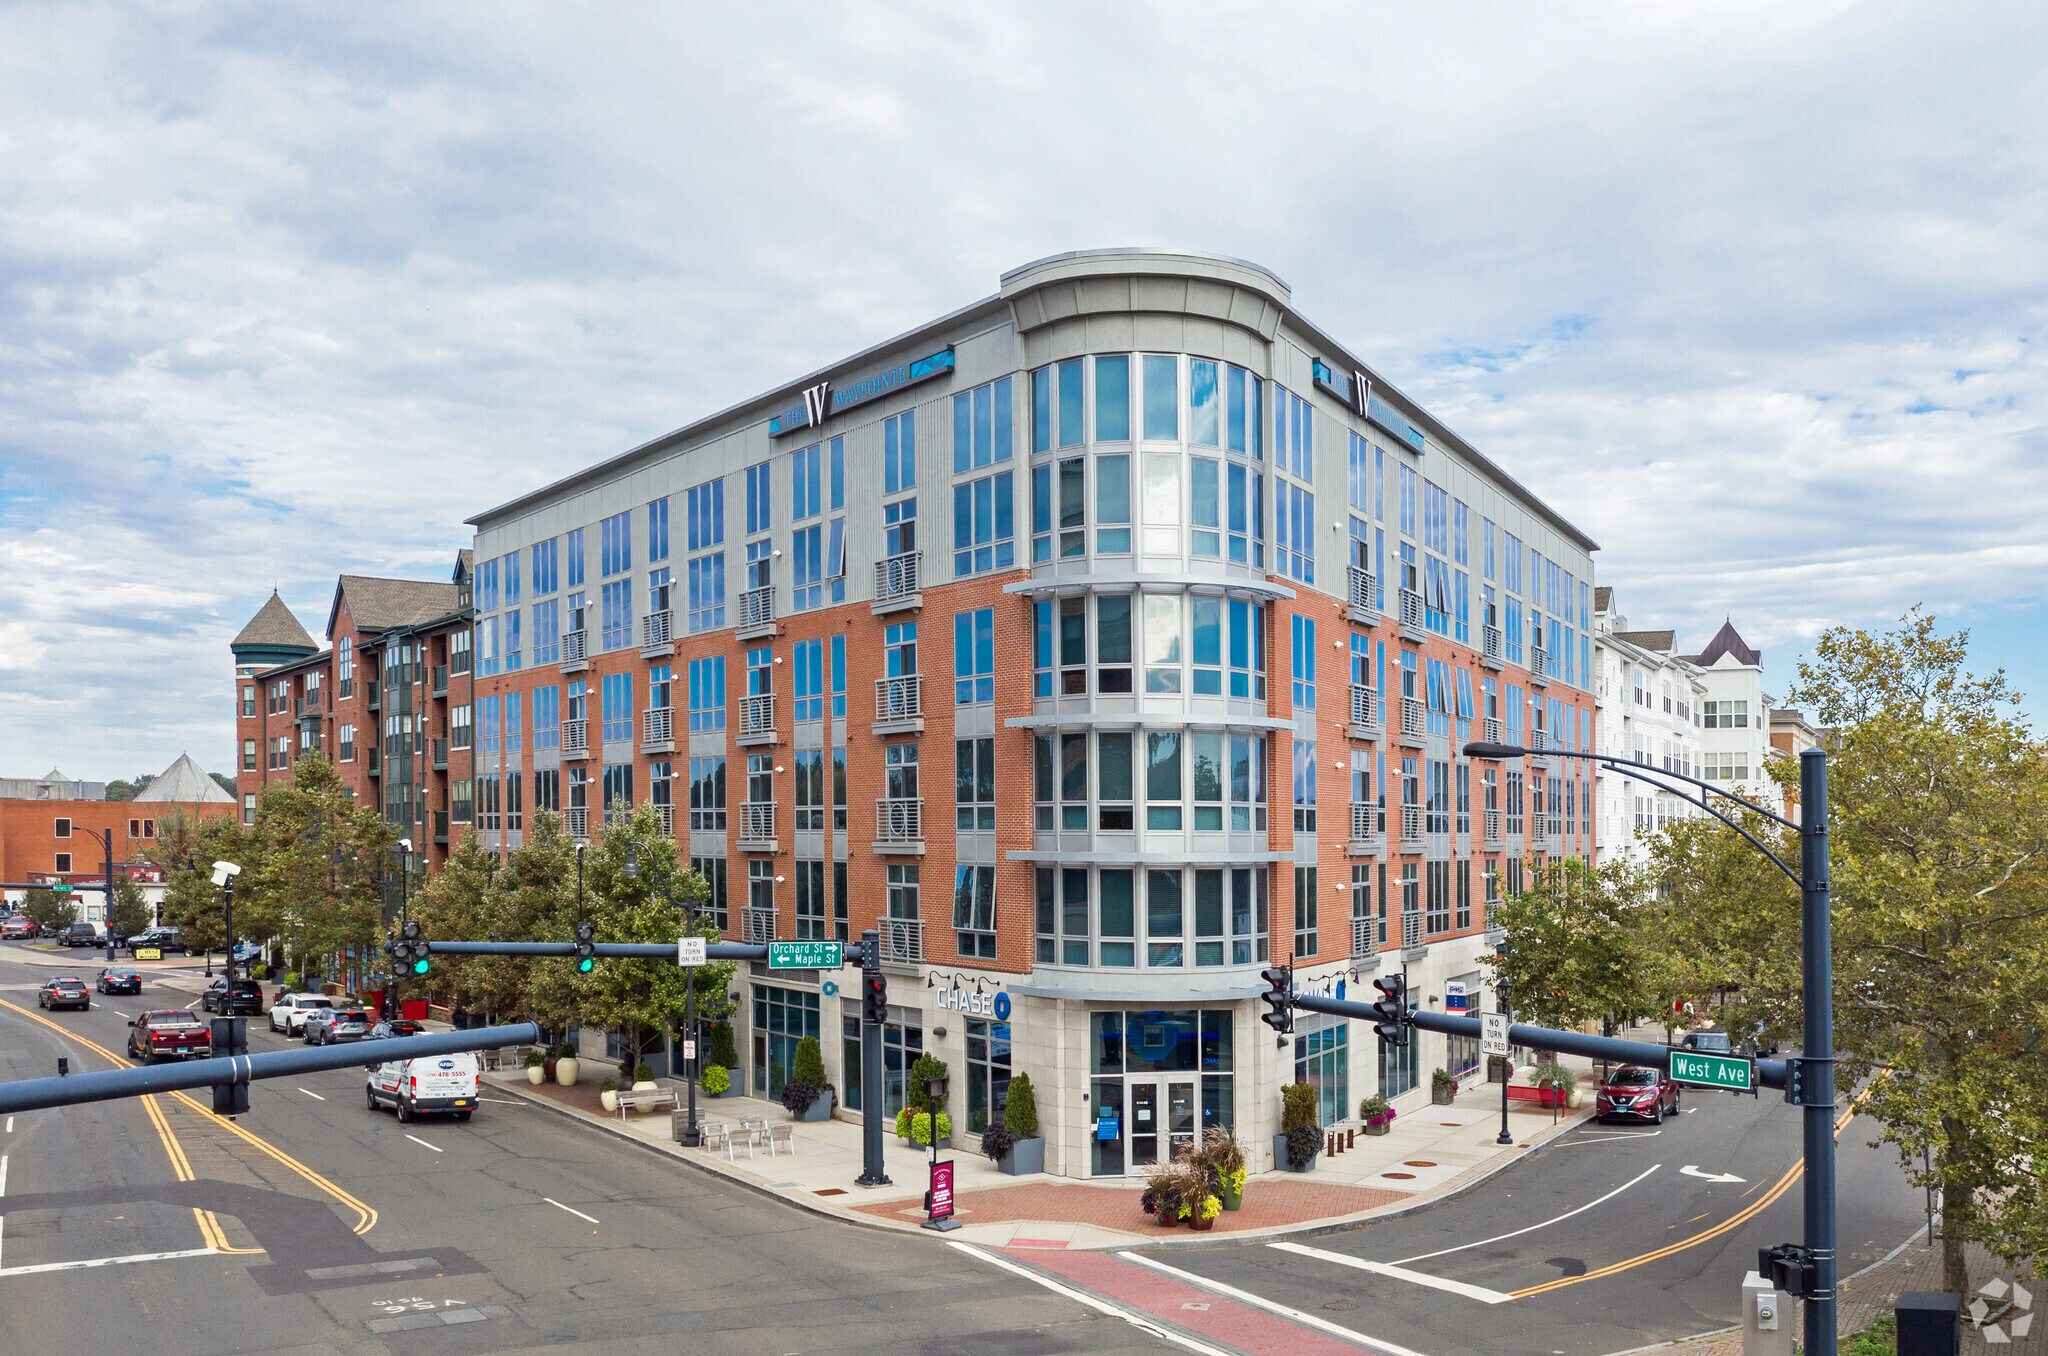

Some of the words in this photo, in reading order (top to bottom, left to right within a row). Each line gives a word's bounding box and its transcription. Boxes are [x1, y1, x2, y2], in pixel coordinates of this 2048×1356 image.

[784, 405, 804, 427] THE
[802, 381, 829, 428] W
[835, 366, 906, 407] WAYPOINTE
[1354, 370, 1372, 419] W
[773, 943, 810, 954] Orchard
[813, 943, 823, 954] St
[795, 953, 822, 967] Maple
[825, 953, 835, 964] St
[937, 986, 993, 1016] CHASE
[1489, 1018, 1500, 1028] NO
[1486, 1029, 1503, 1039] TURN
[1483, 1040, 1492, 1050] ON
[1493, 1041, 1506, 1052] RED
[1676, 1058, 1710, 1078] West
[1717, 1063, 1745, 1083] Ave
